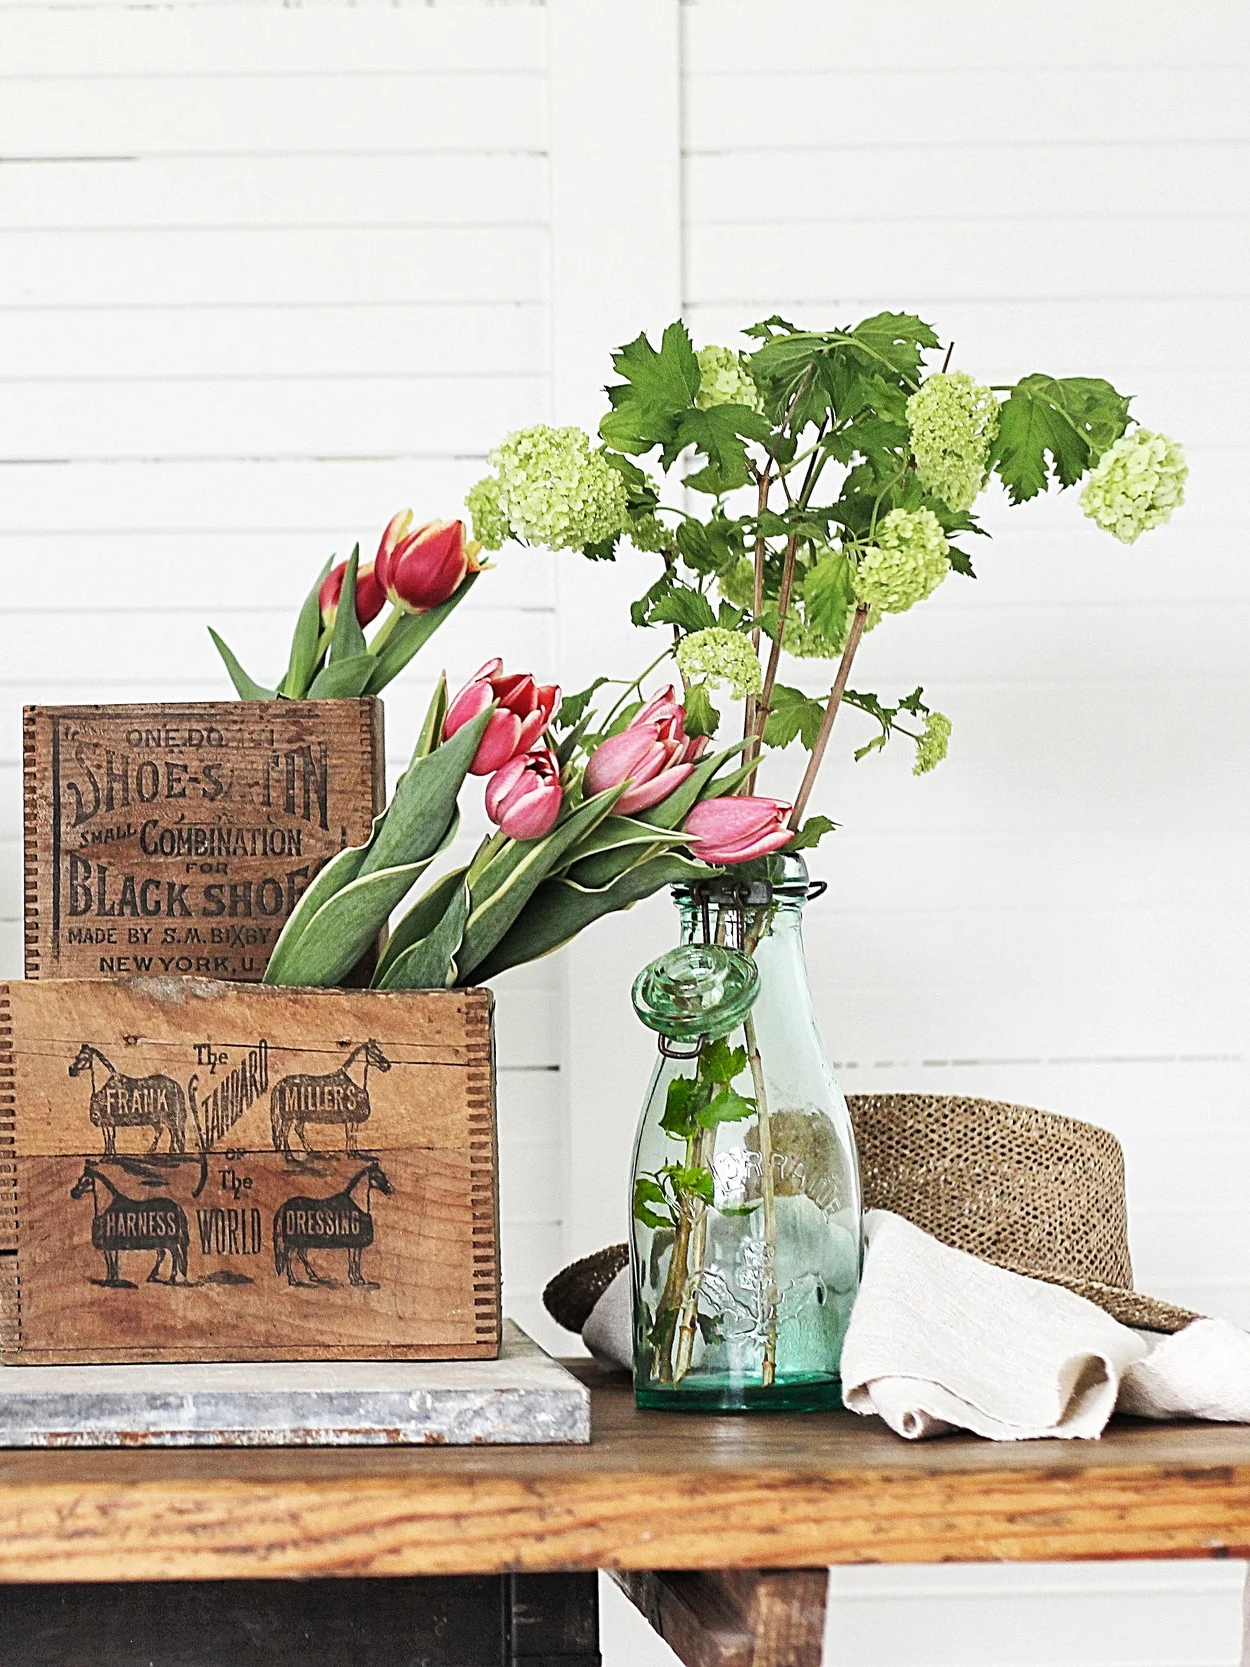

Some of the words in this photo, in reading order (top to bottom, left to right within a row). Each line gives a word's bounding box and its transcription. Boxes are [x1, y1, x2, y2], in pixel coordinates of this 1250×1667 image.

[125, 728, 181, 748] ONE
[78, 823, 137, 849] SMALL
[139, 818, 302, 857] COMBINATION
[185, 862, 229, 875] FOR
[67, 853, 193, 917] BLACK
[67, 928, 118, 945] MADE
[128, 928, 152, 944] BY
[99, 956, 152, 972] NEW
[193, 1043, 229, 1075] The
[105, 1087, 170, 1114] FRANK
[188, 1038, 269, 1199] STANDARD
[218, 1169, 254, 1200] The
[105, 1211, 177, 1237] HARNESS
[196, 1207, 263, 1257] WORLD
[285, 1209, 361, 1236] DRESSING
